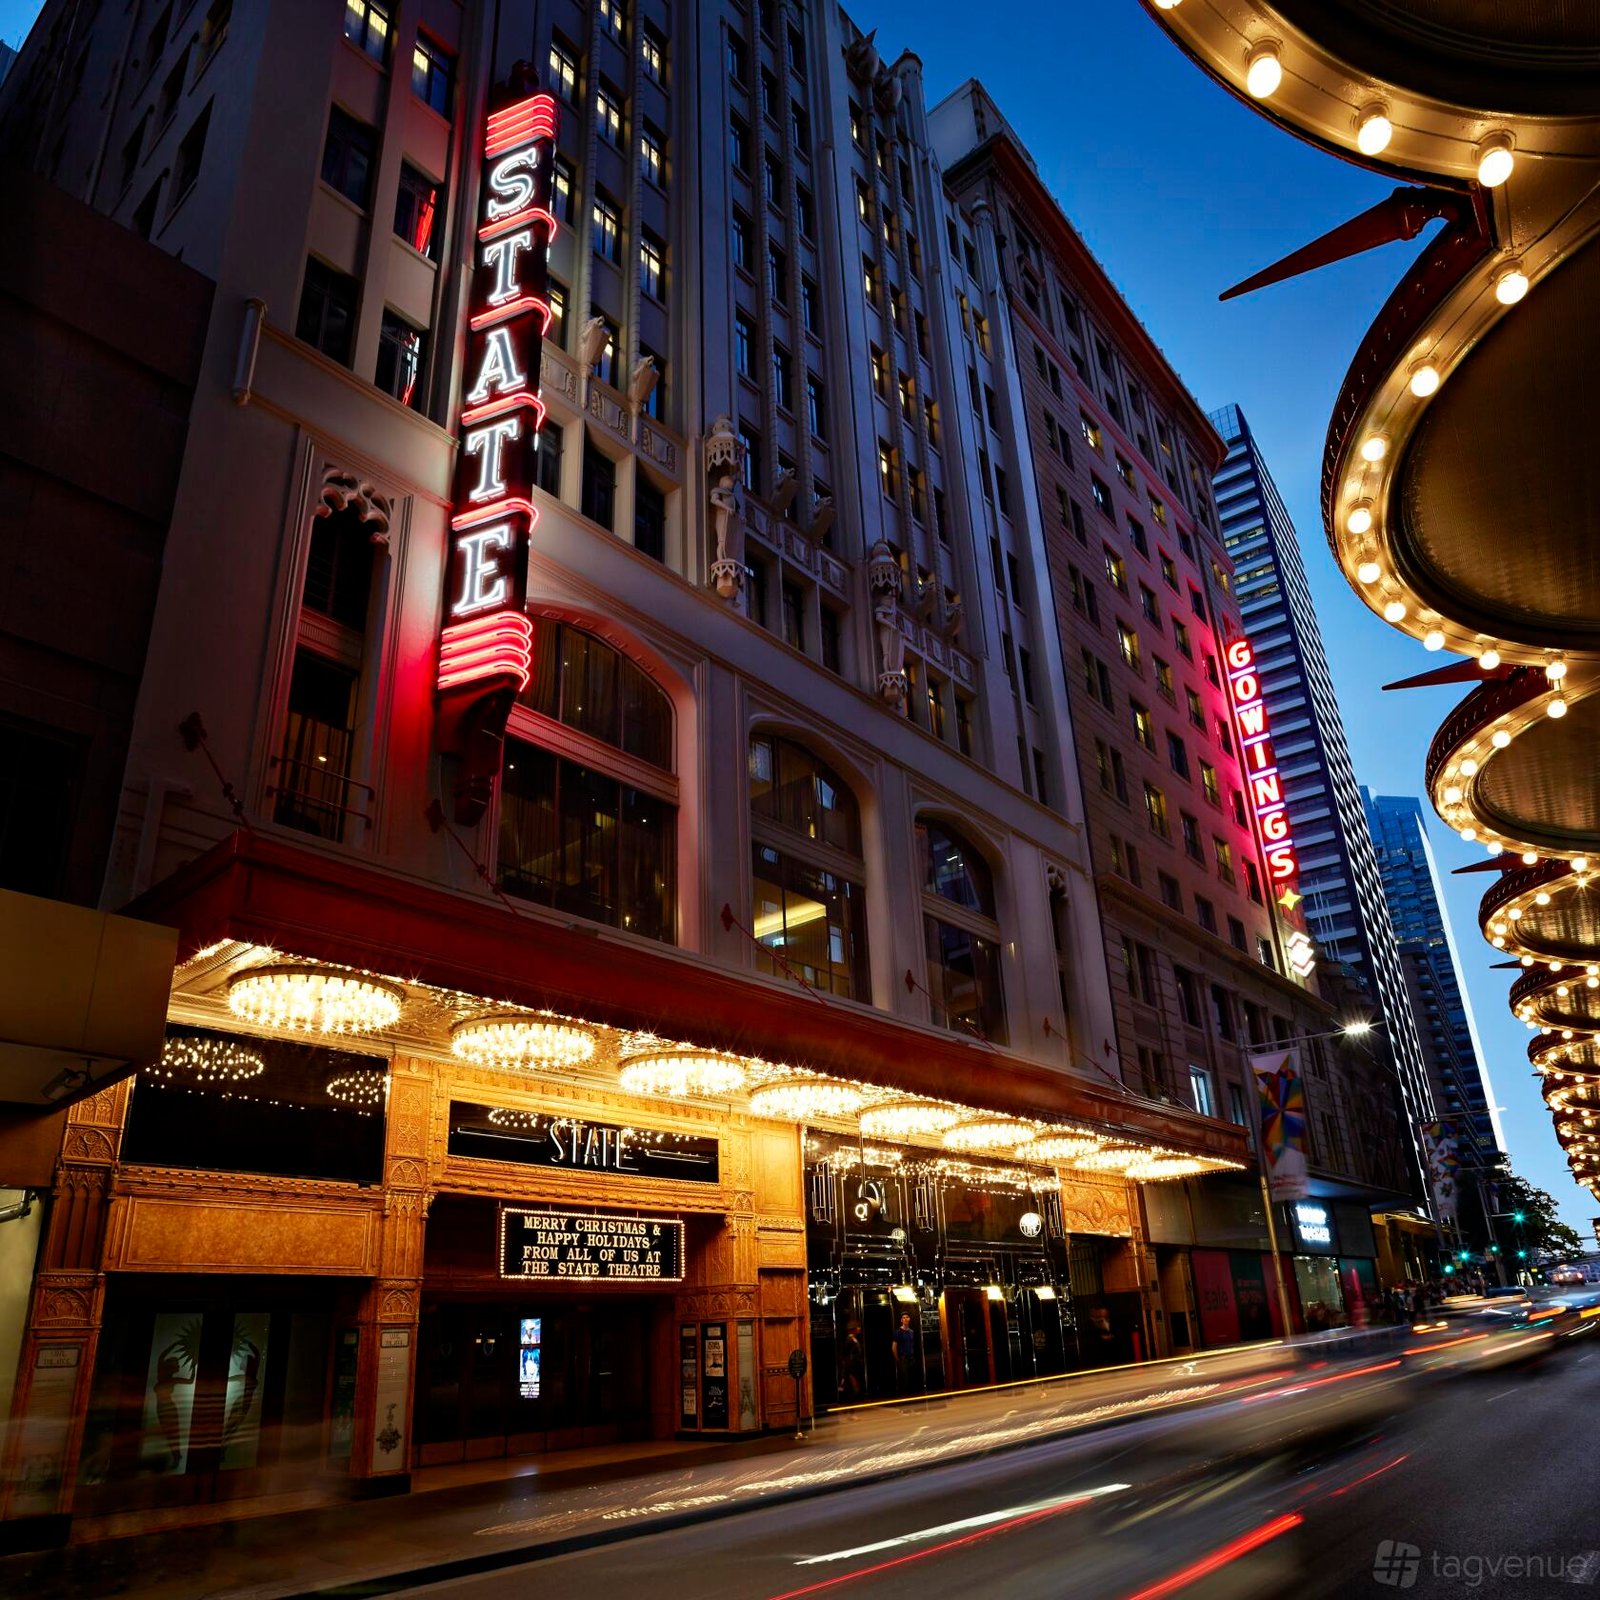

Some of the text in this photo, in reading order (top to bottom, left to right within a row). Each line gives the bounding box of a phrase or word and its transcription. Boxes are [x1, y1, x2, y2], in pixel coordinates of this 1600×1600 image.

[453, 147, 537, 615] STATE
[1228, 640, 1295, 879] GOWINGS
[549, 1119, 640, 1172] STATE
[523, 1215, 662, 1236] MERRY CHRISTMAS &
[536, 1230, 651, 1249] HAPPY HOLIDAYS
[522, 1245, 662, 1263] FROM ALL OF US AT
[522, 1260, 662, 1277] THE STATE THEATRE
